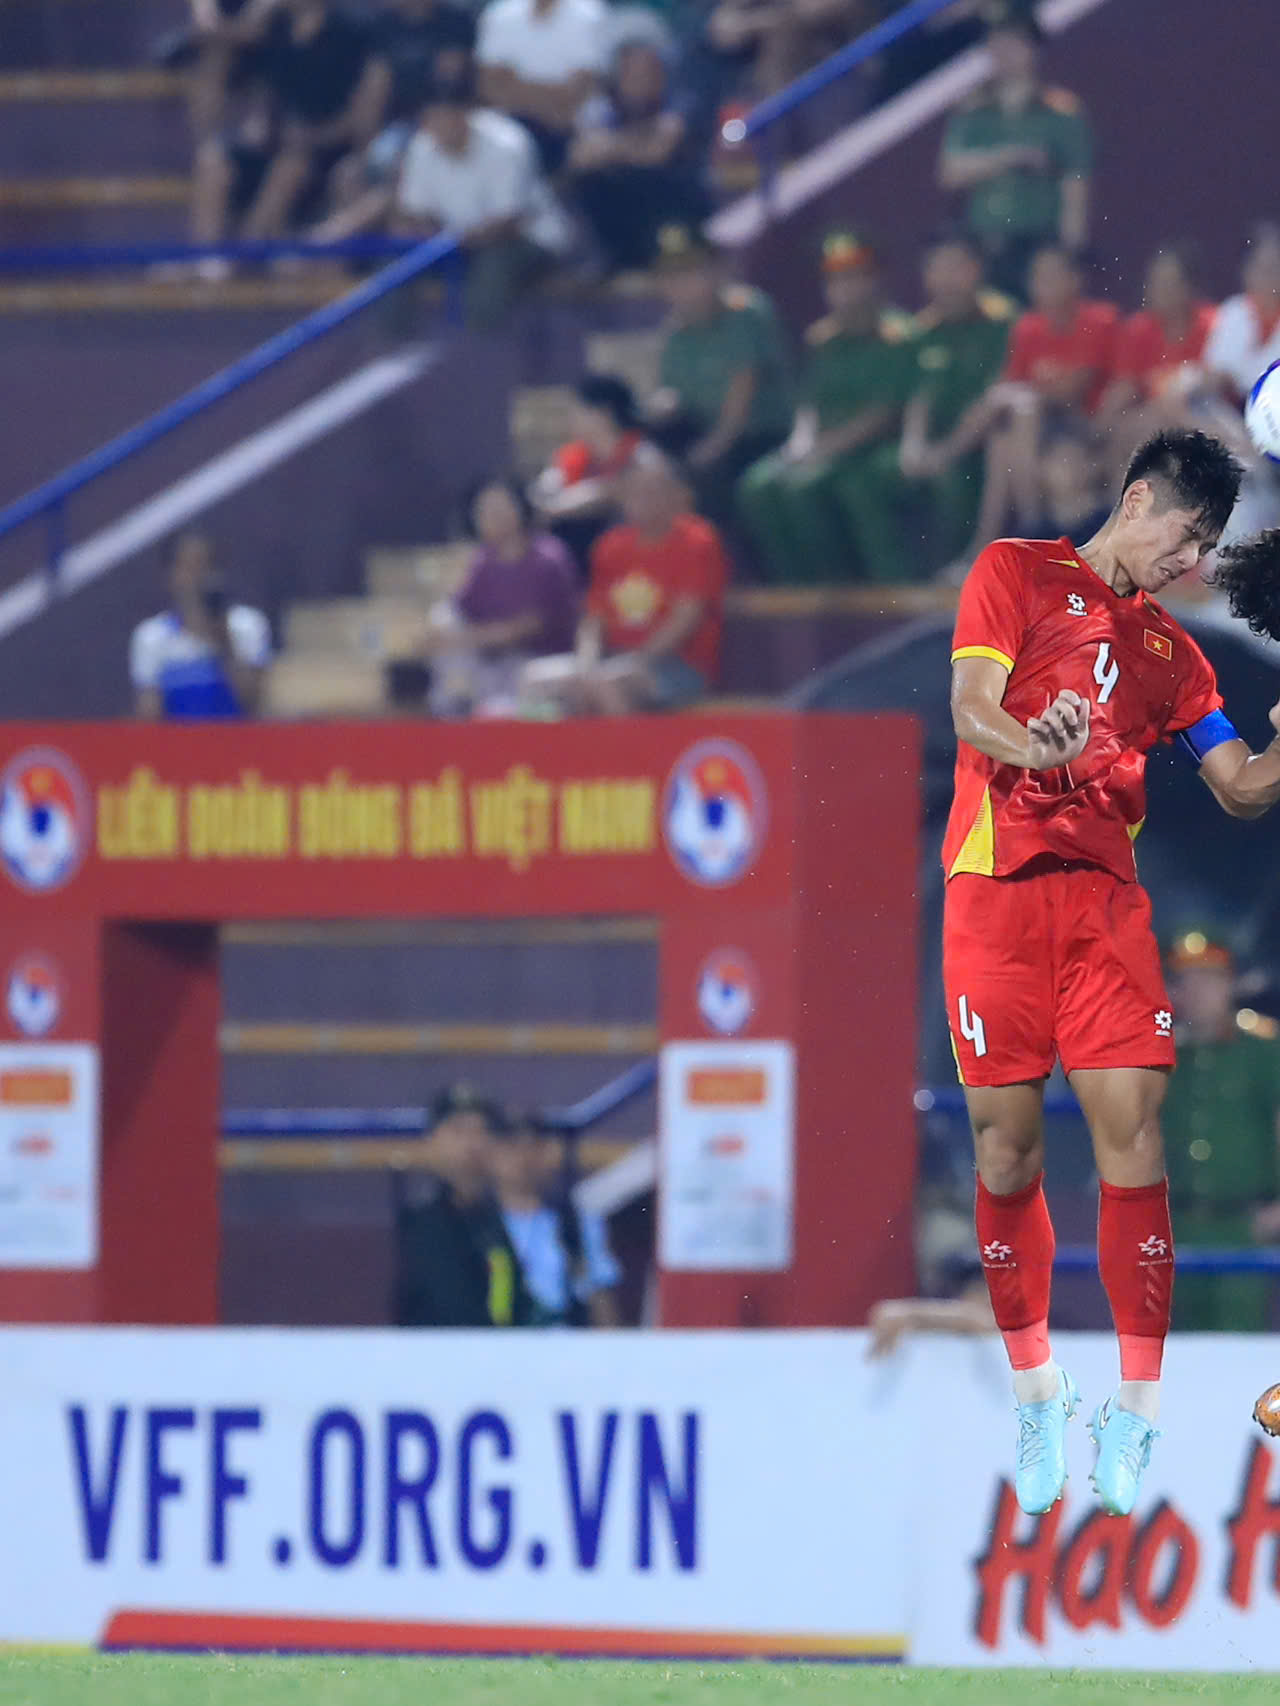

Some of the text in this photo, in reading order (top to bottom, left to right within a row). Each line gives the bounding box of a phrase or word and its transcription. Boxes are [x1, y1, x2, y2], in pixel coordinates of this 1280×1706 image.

[1093, 643, 1120, 703] 4
[957, 993, 988, 1057] 4
[66, 1405, 701, 1571] VFF.ORG.VN
